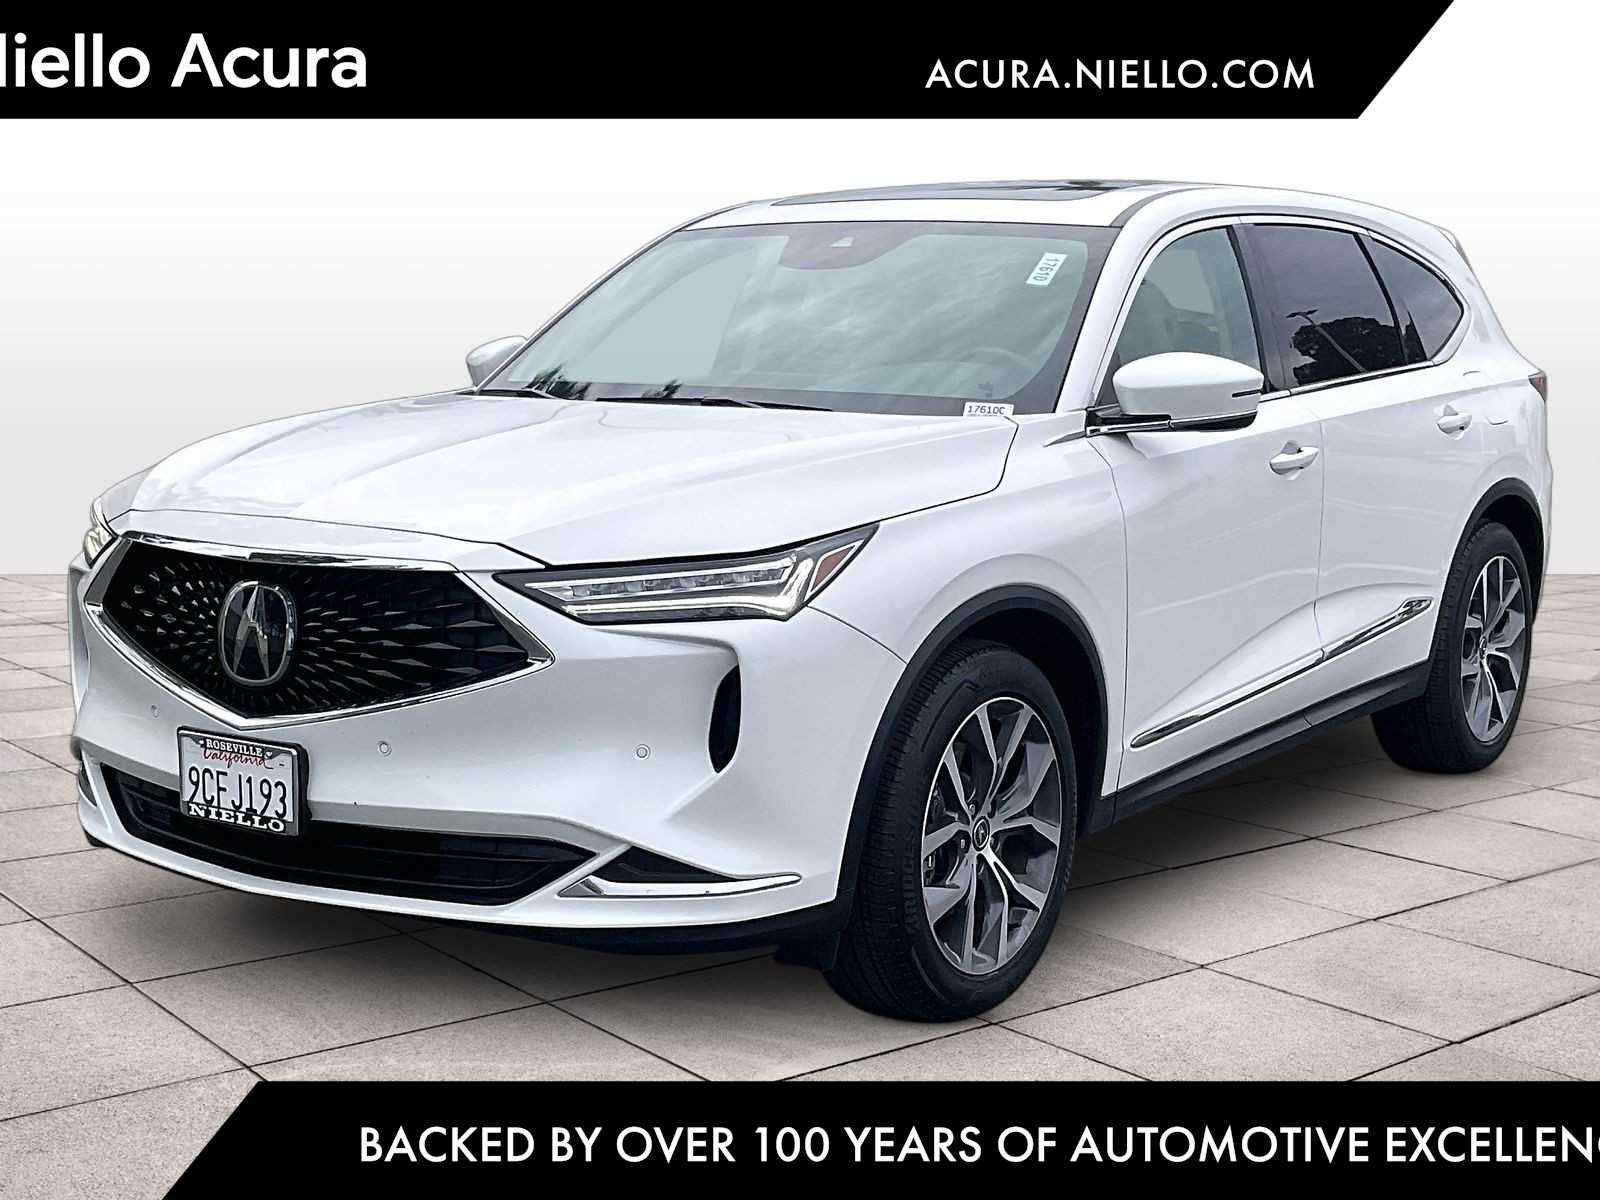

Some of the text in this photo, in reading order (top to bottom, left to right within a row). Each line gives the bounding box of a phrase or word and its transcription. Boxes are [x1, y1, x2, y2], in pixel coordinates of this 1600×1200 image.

[1033, 257, 1060, 282] 17610
[967, 405, 1006, 415] 17610C
[205, 738, 263, 757] ROSEVILLE
[188, 765, 287, 819] 9CFJ193
[188, 803, 285, 832] NIELLO
